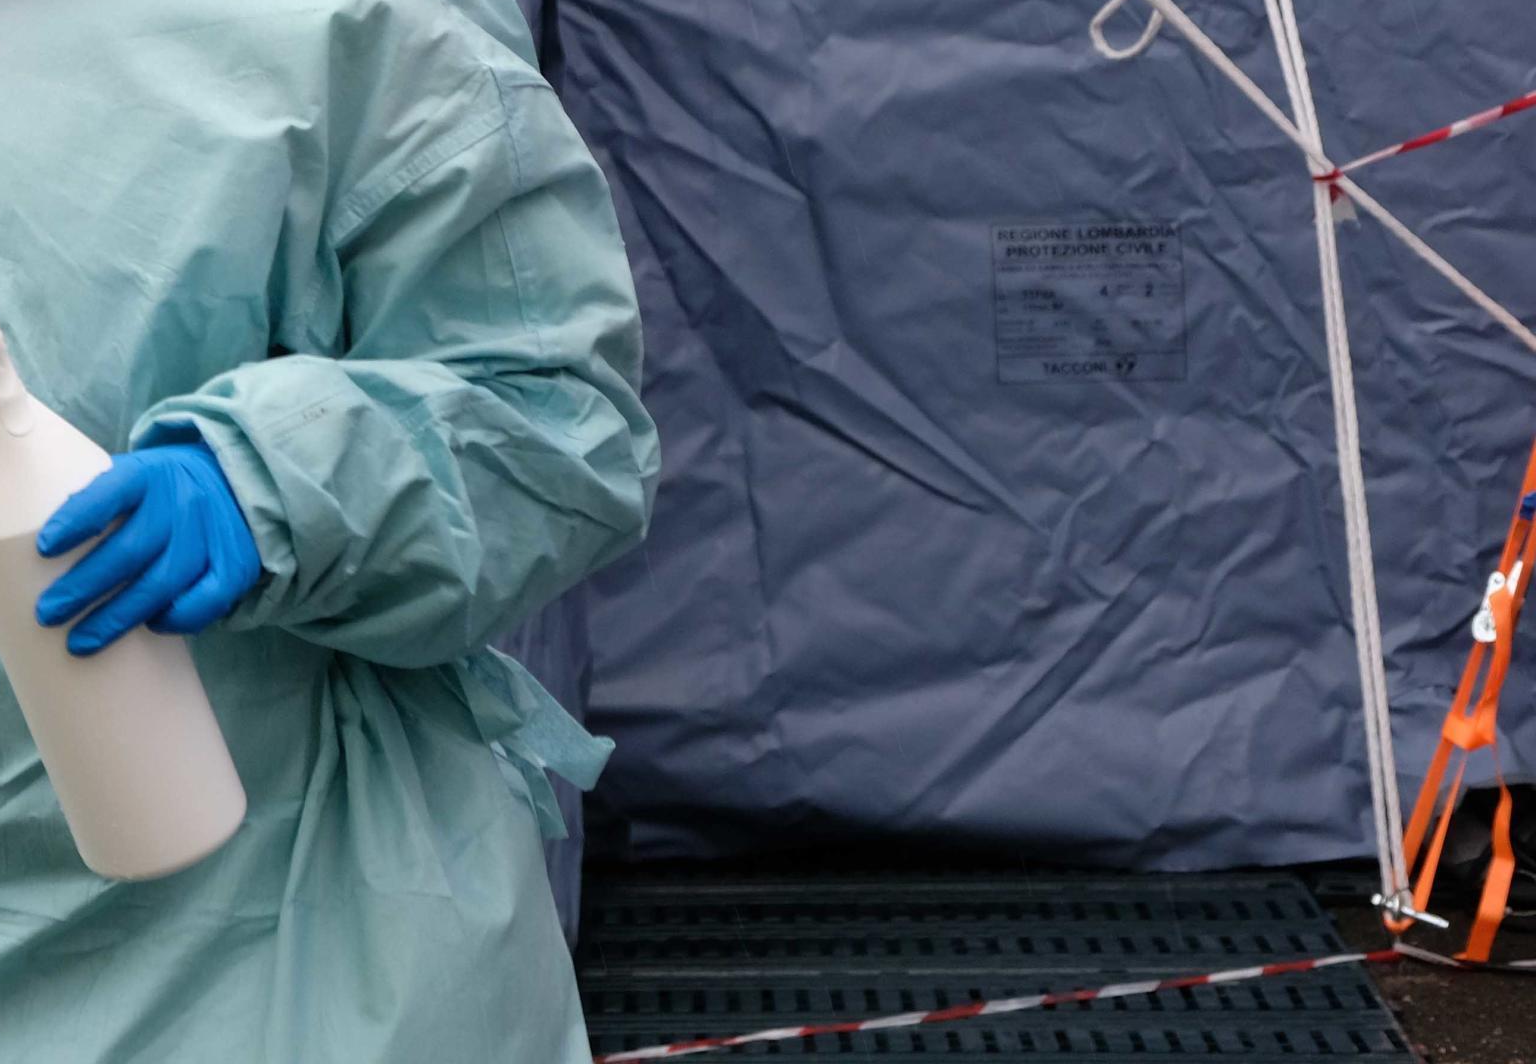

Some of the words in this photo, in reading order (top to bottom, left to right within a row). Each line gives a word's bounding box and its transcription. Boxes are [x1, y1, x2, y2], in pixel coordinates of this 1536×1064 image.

[997, 228, 1070, 240] REGIONE
[1078, 225, 1176, 239] LOMBARDIA
[1006, 243, 1108, 257] PROTEZIONE
[1116, 242, 1167, 255] CIVILE
[1042, 360, 1107, 375] TACCONI
